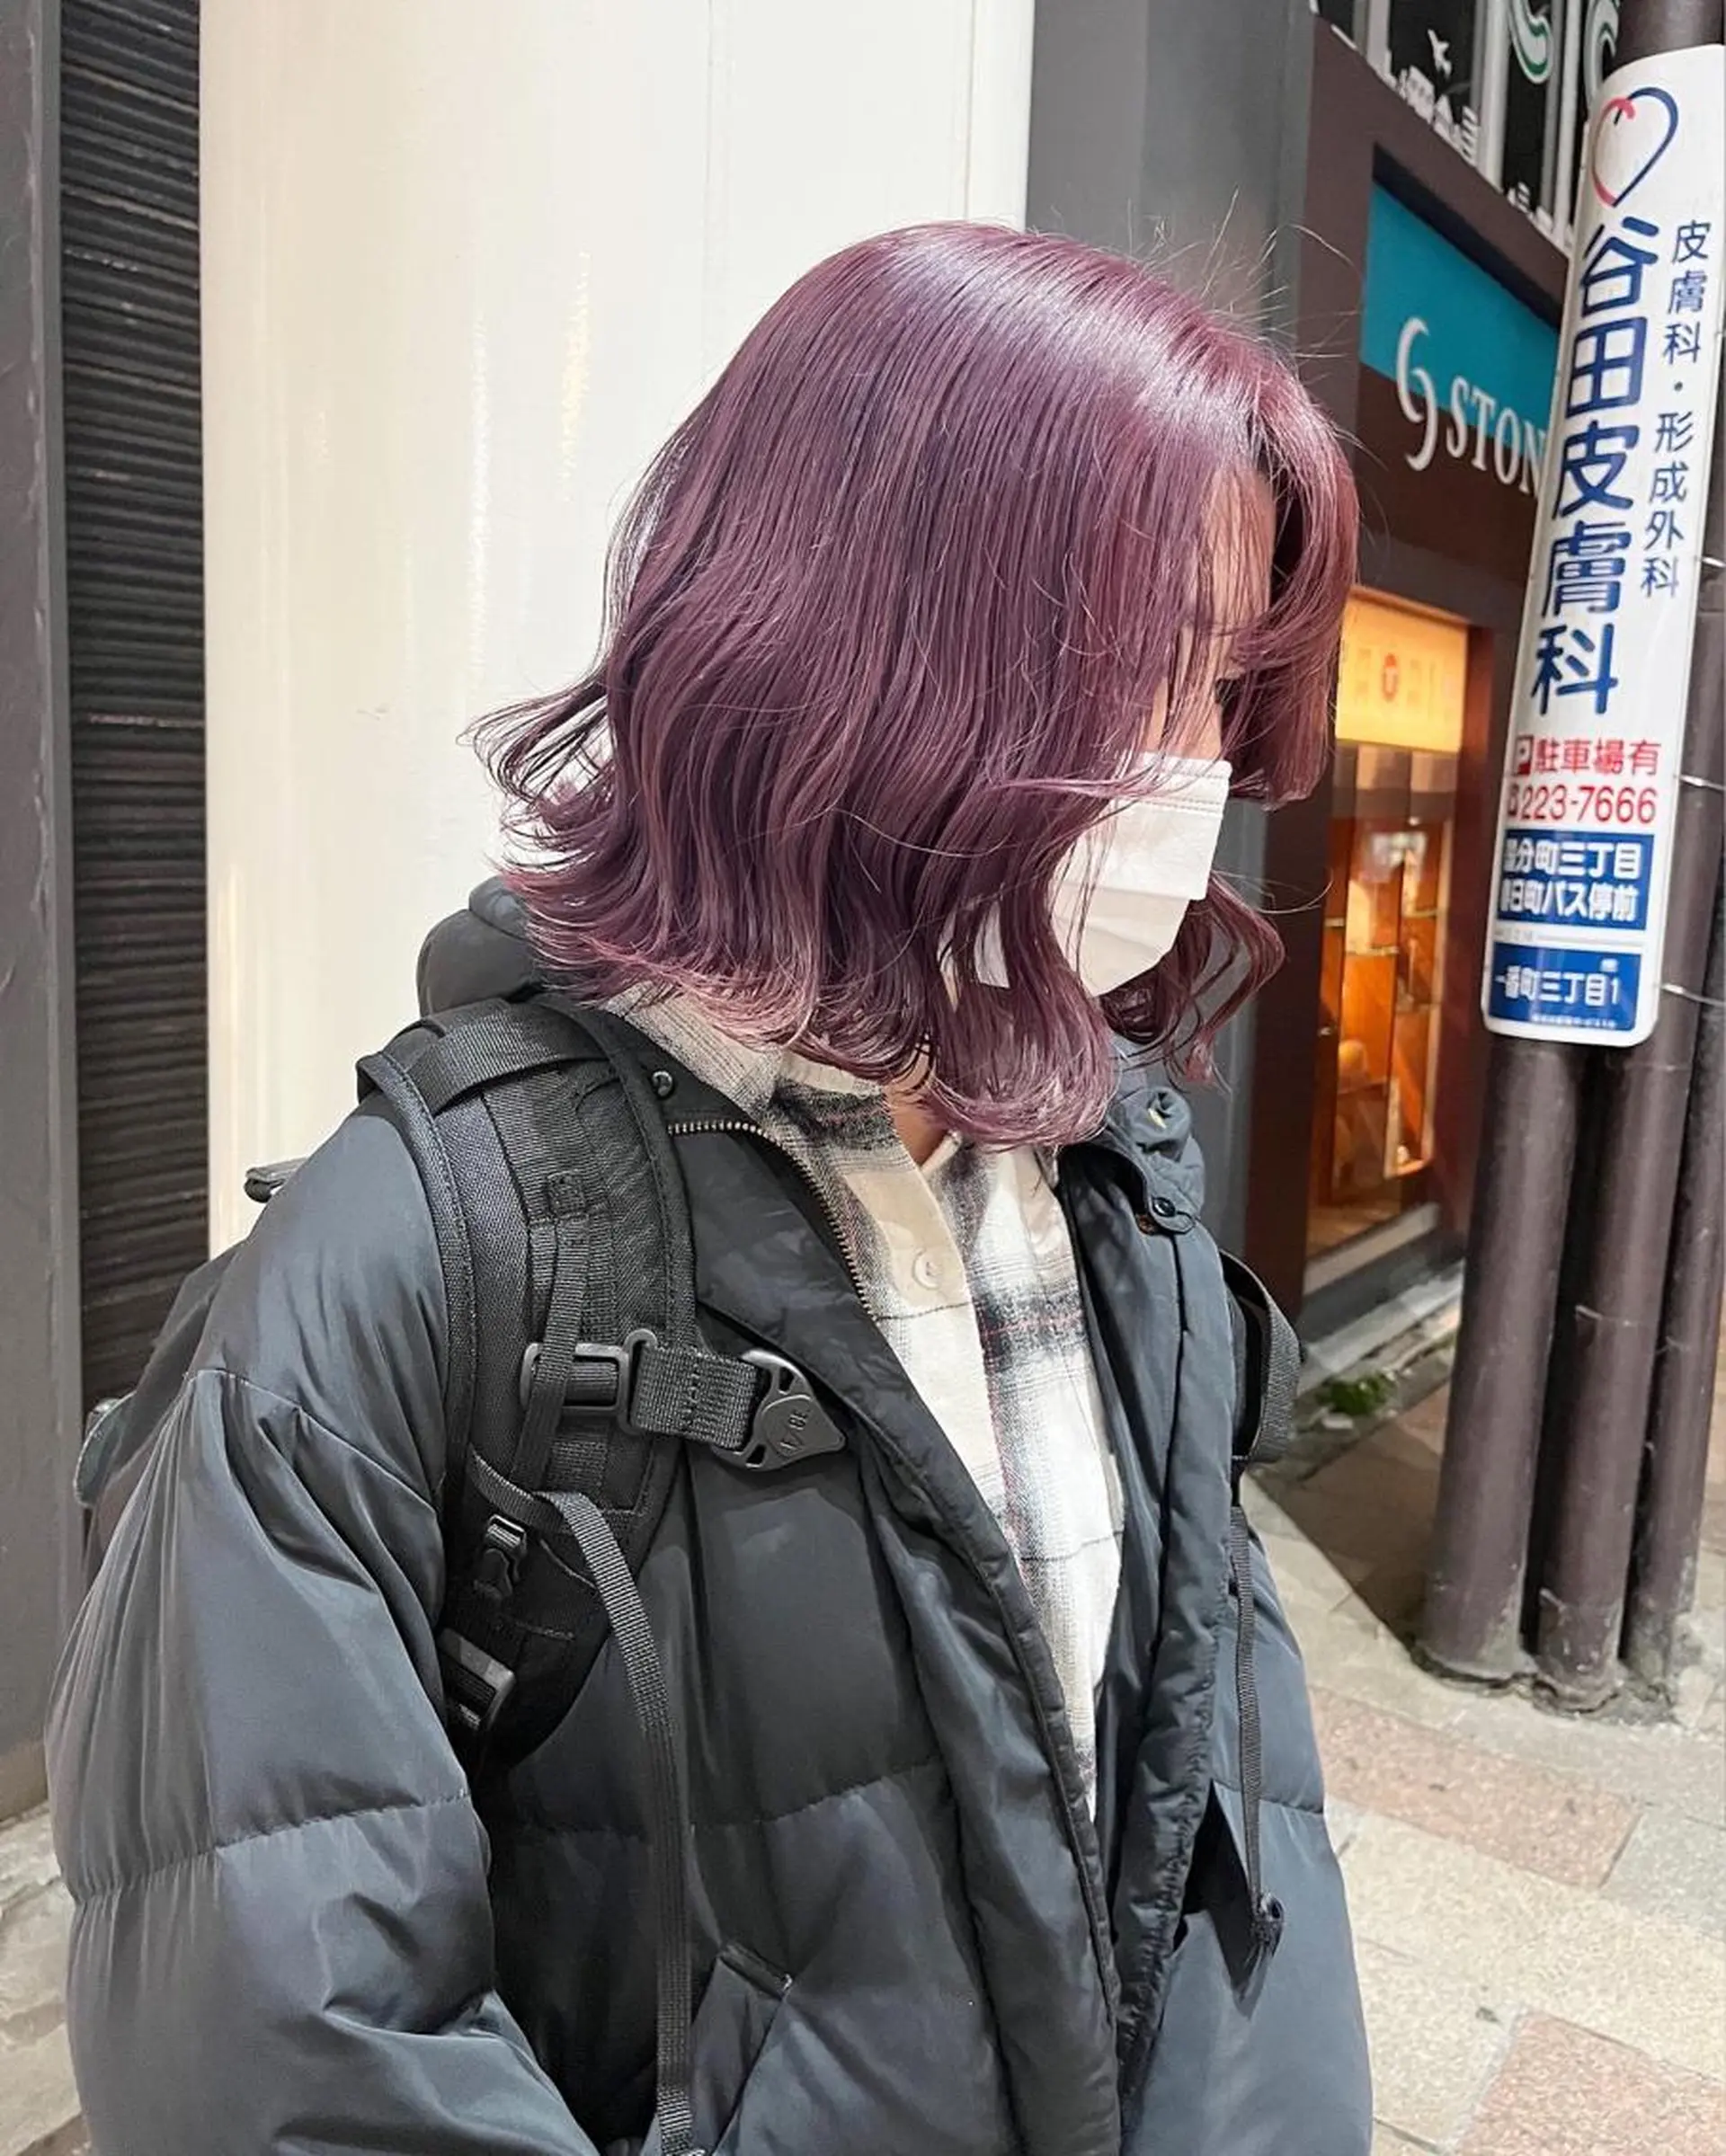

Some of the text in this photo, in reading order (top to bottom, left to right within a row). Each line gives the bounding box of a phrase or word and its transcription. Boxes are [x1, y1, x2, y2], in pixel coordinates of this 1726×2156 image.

[1530, 217, 1660, 715] 谷田皮膚科
[1641, 219, 1712, 599] 皮膚科・形成外科
